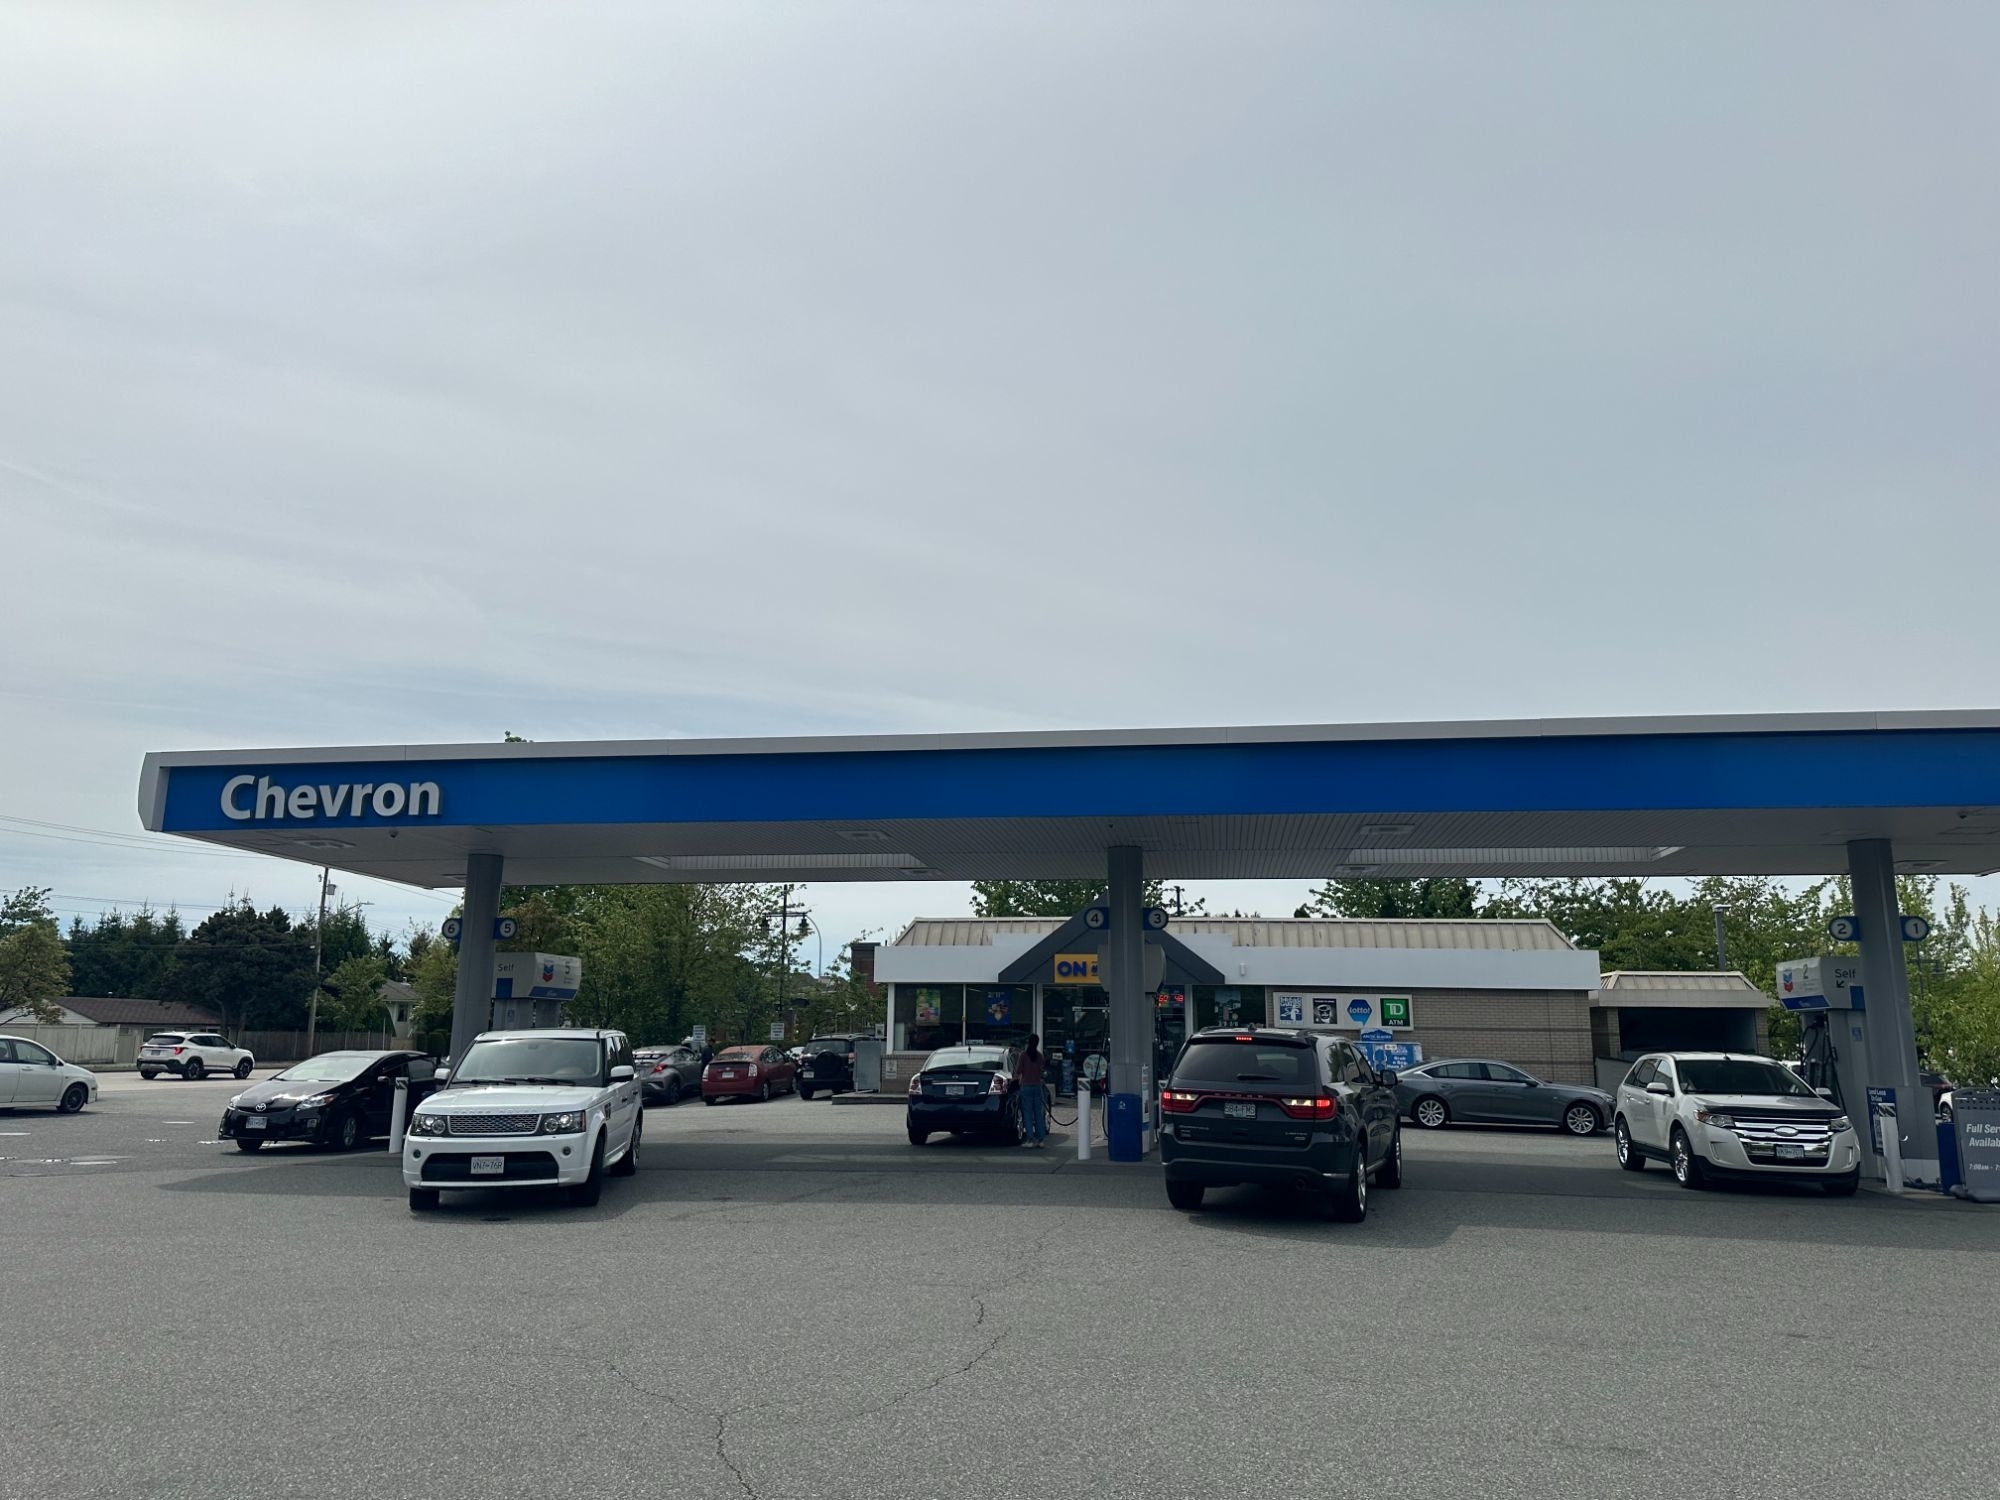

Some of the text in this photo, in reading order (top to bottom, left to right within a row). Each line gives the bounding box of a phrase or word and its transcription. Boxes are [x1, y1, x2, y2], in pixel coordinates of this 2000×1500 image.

[220, 774, 441, 821] Chevron
[1090, 913, 1099, 924] 4
[1153, 913, 1162, 924] 3
[447, 923, 456, 934] 6
[503, 923, 512, 934] 5
[1836, 923, 1847, 934] 2
[1912, 923, 1919, 934] 1
[497, 963, 514, 972] Self
[1057, 961, 1087, 977] ON
[1802, 963, 1809, 980] 2
[1834, 968, 1857, 978] Self
[1385, 1003, 1404, 1016] TD
[1966, 1123, 1981, 1133] Full
